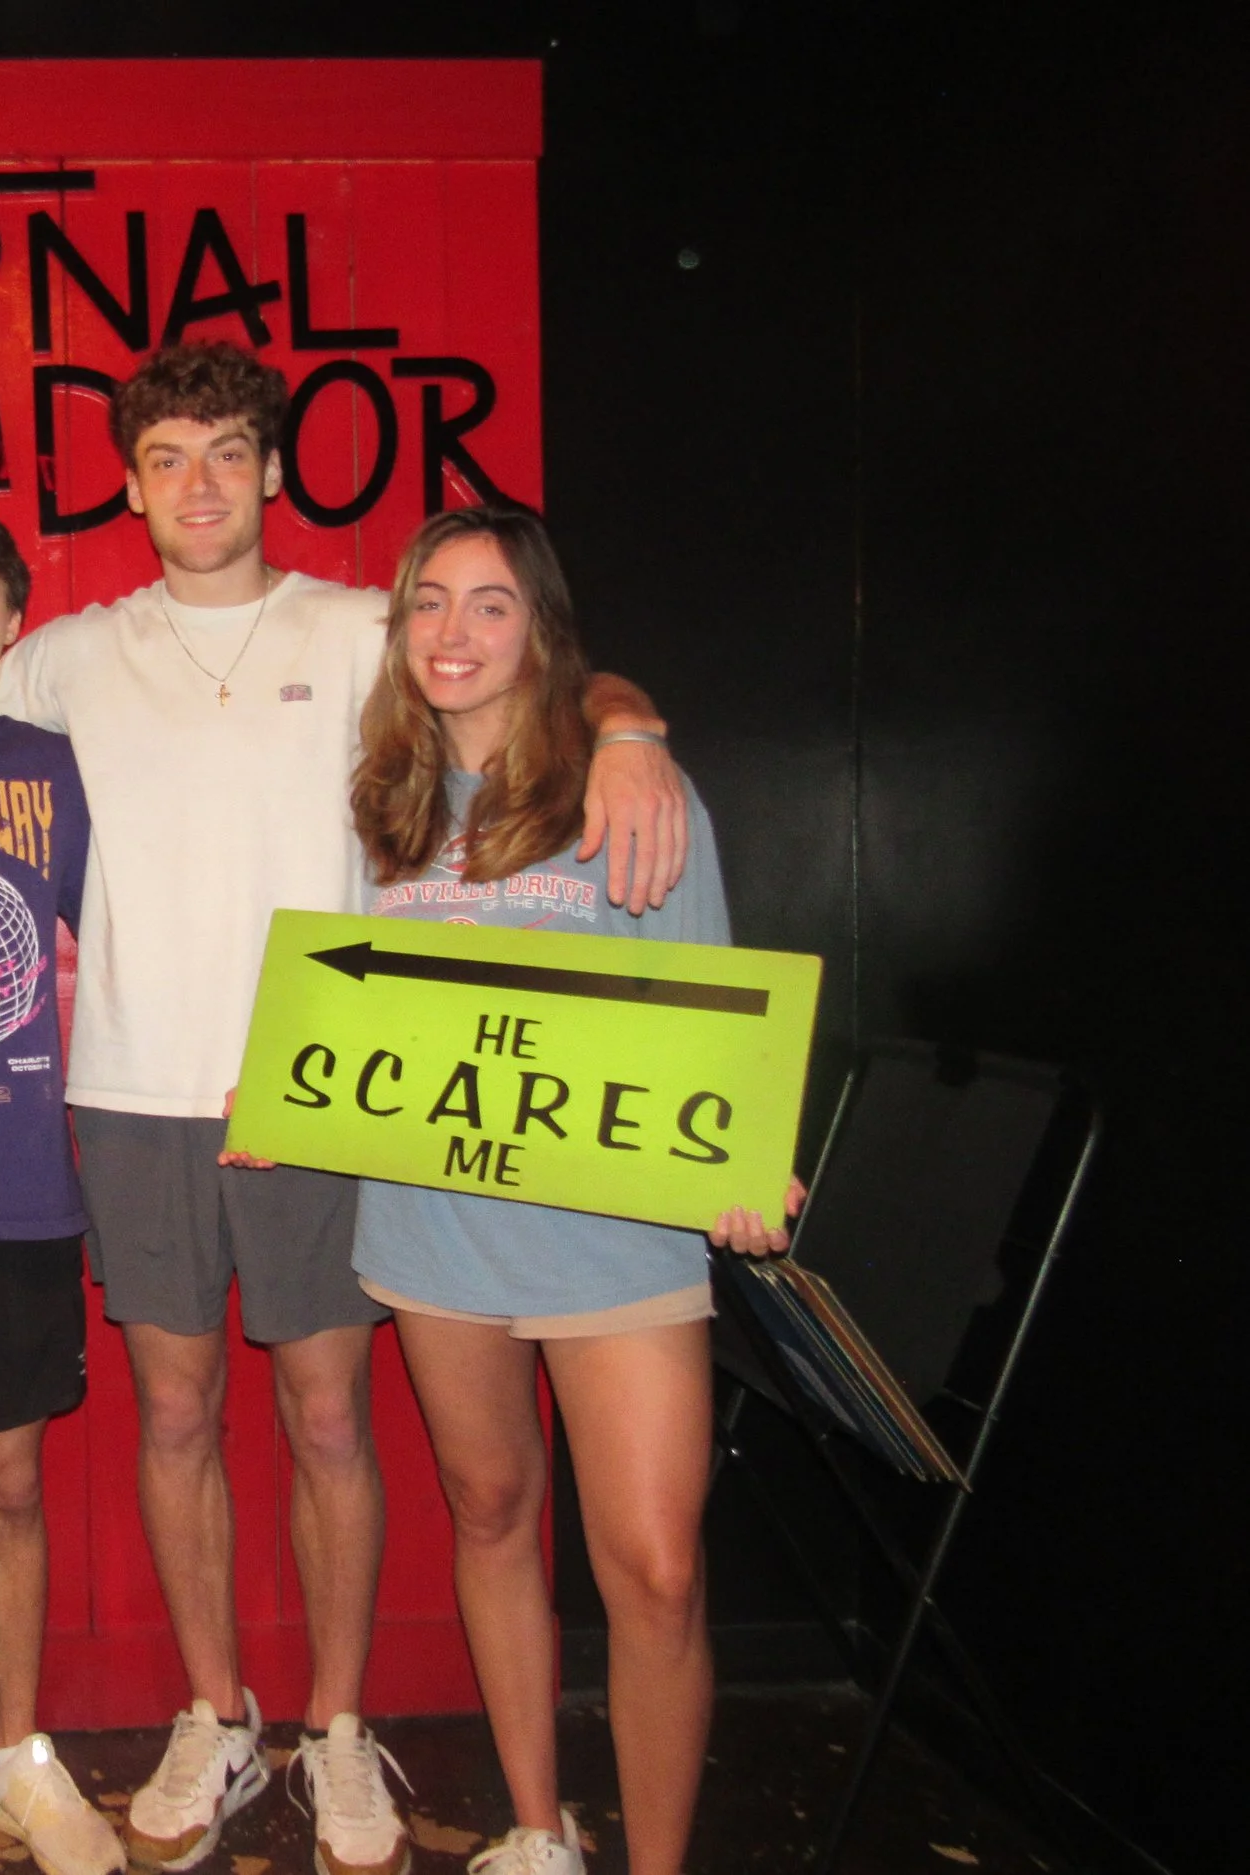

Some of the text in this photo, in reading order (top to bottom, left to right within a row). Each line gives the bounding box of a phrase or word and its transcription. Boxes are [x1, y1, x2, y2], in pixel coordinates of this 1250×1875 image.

[33, 351, 542, 536] DOR
[482, 898, 598, 923] OF THE FUTURE
[505, 873, 595, 907] DRIVE
[473, 1014, 543, 1060] HE
[283, 1043, 734, 1165] SCARES
[443, 1136, 525, 1188] ME
